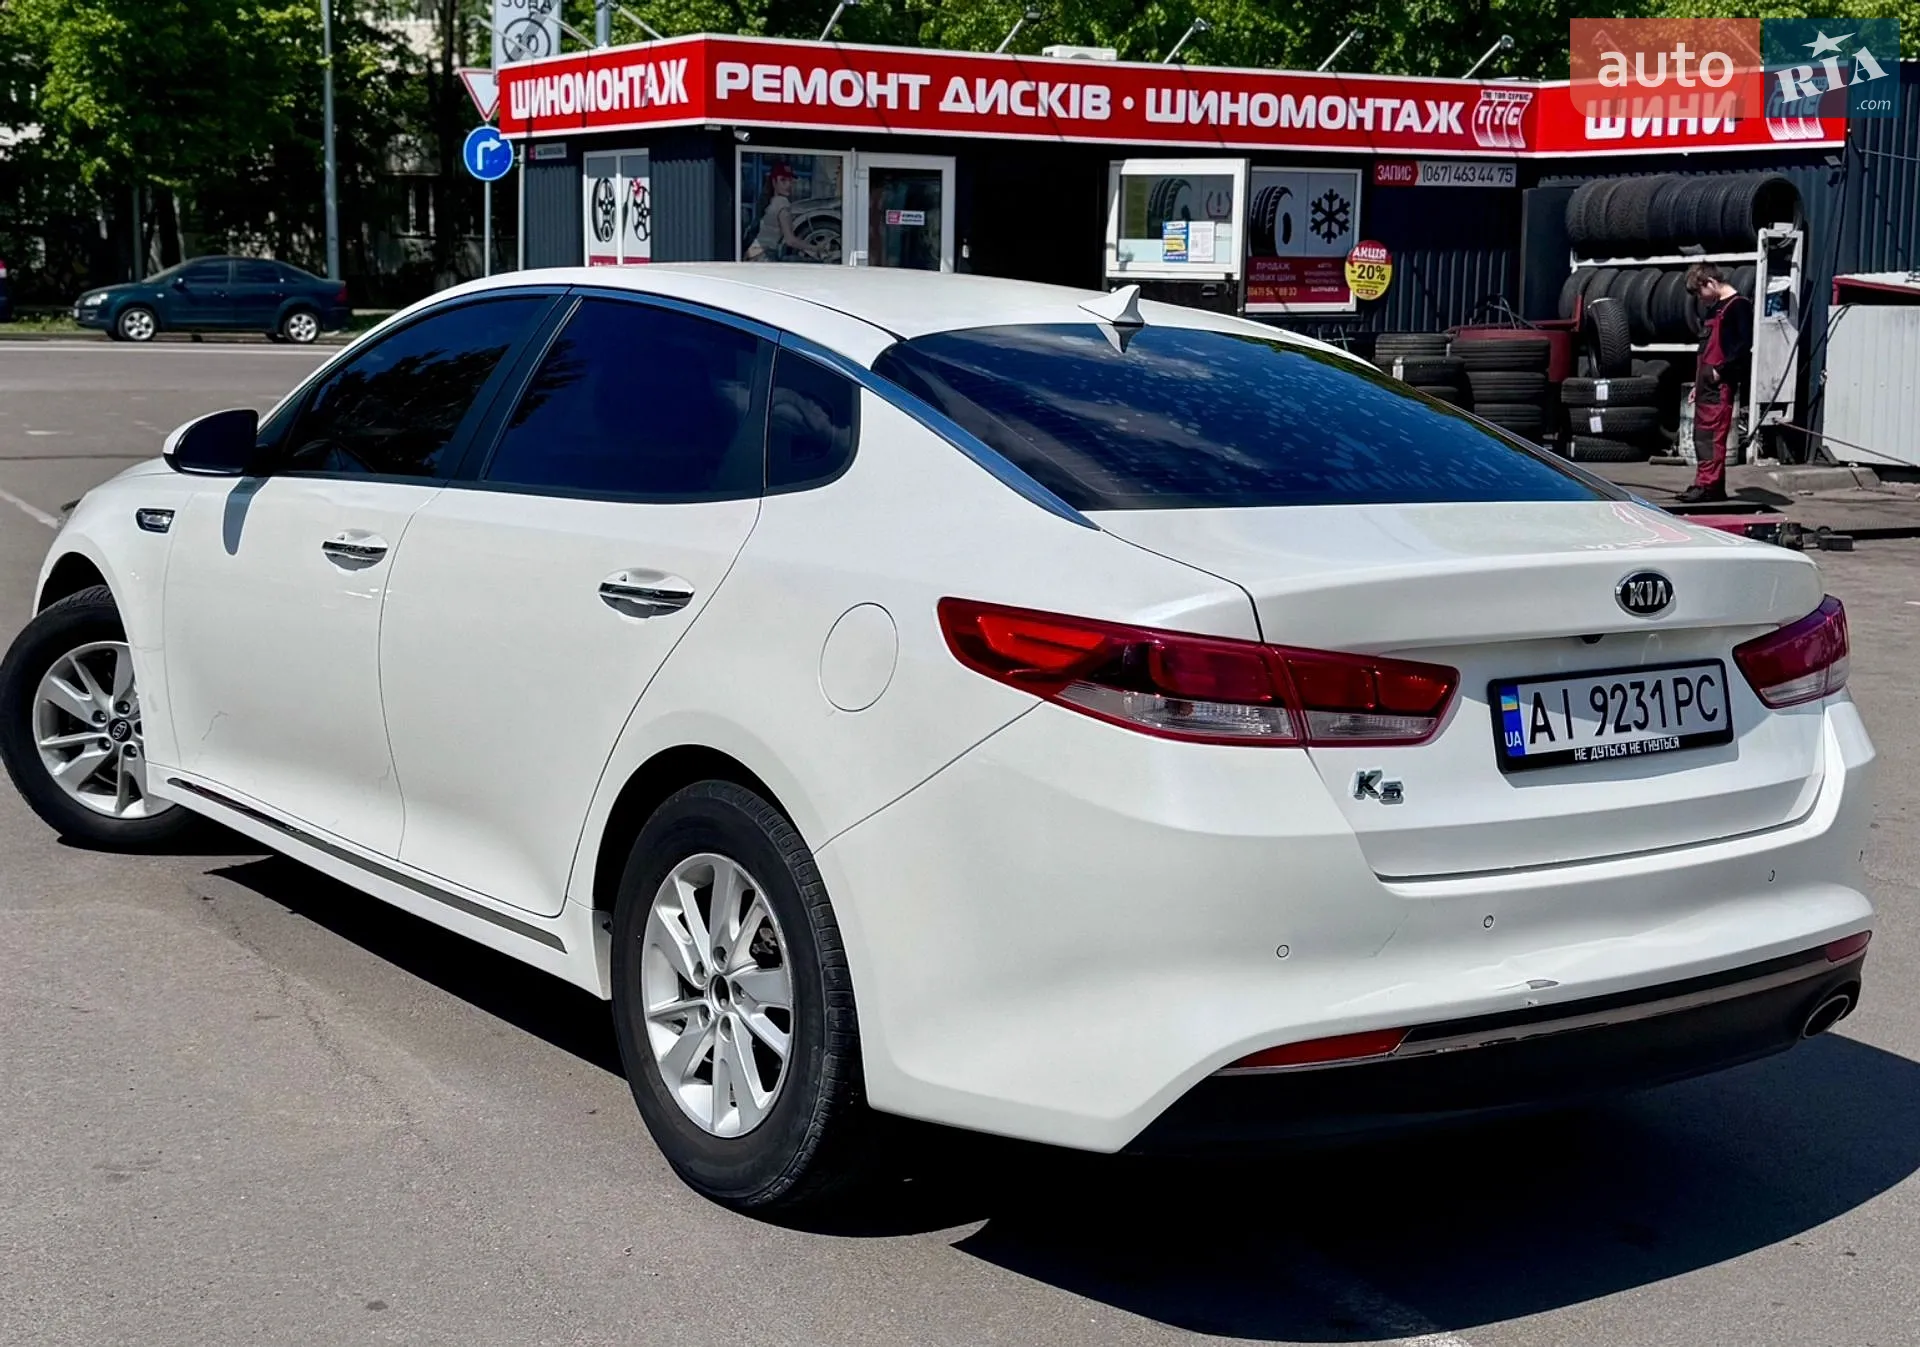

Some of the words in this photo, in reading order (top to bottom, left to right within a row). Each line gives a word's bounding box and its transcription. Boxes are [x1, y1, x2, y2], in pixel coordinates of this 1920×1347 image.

[510, 57, 689, 120] ШИНОМОНТАЖ
[716, 61, 931, 110] РЕМОНТ
[939, 76, 1111, 120] ДИСКІВ
[1145, 87, 1465, 134] ШИНОМОНТАЖ
[1585, 89, 1738, 140] ШИНИ
[1377, 164, 1412, 181] ЗАПИС
[1422, 163, 1452, 183] (067)
[1454, 165, 1476, 182] 463
[1478, 166, 1494, 182] 44
[1498, 167, 1513, 183] 75
[1353, 246, 1387, 260] АКЦІЯ
[1256, 262, 1290, 271] ПРОДАЖ
[1350, 264, 1386, 281] -20%
[1629, 581, 1667, 606] KIA
[1529, 688, 1574, 745] AI
[1589, 679, 1667, 737] 9231
[1672, 674, 1718, 726] PC
[1505, 731, 1522, 748] UA
[1574, 748, 1588, 761] НЕ
[1590, 743, 1627, 760] ДУТЬСЯ
[1629, 741, 1642, 755] НЕ
[1643, 736, 1680, 752] ГНУТЬСЯ
[1353, 769, 1404, 805] K5
